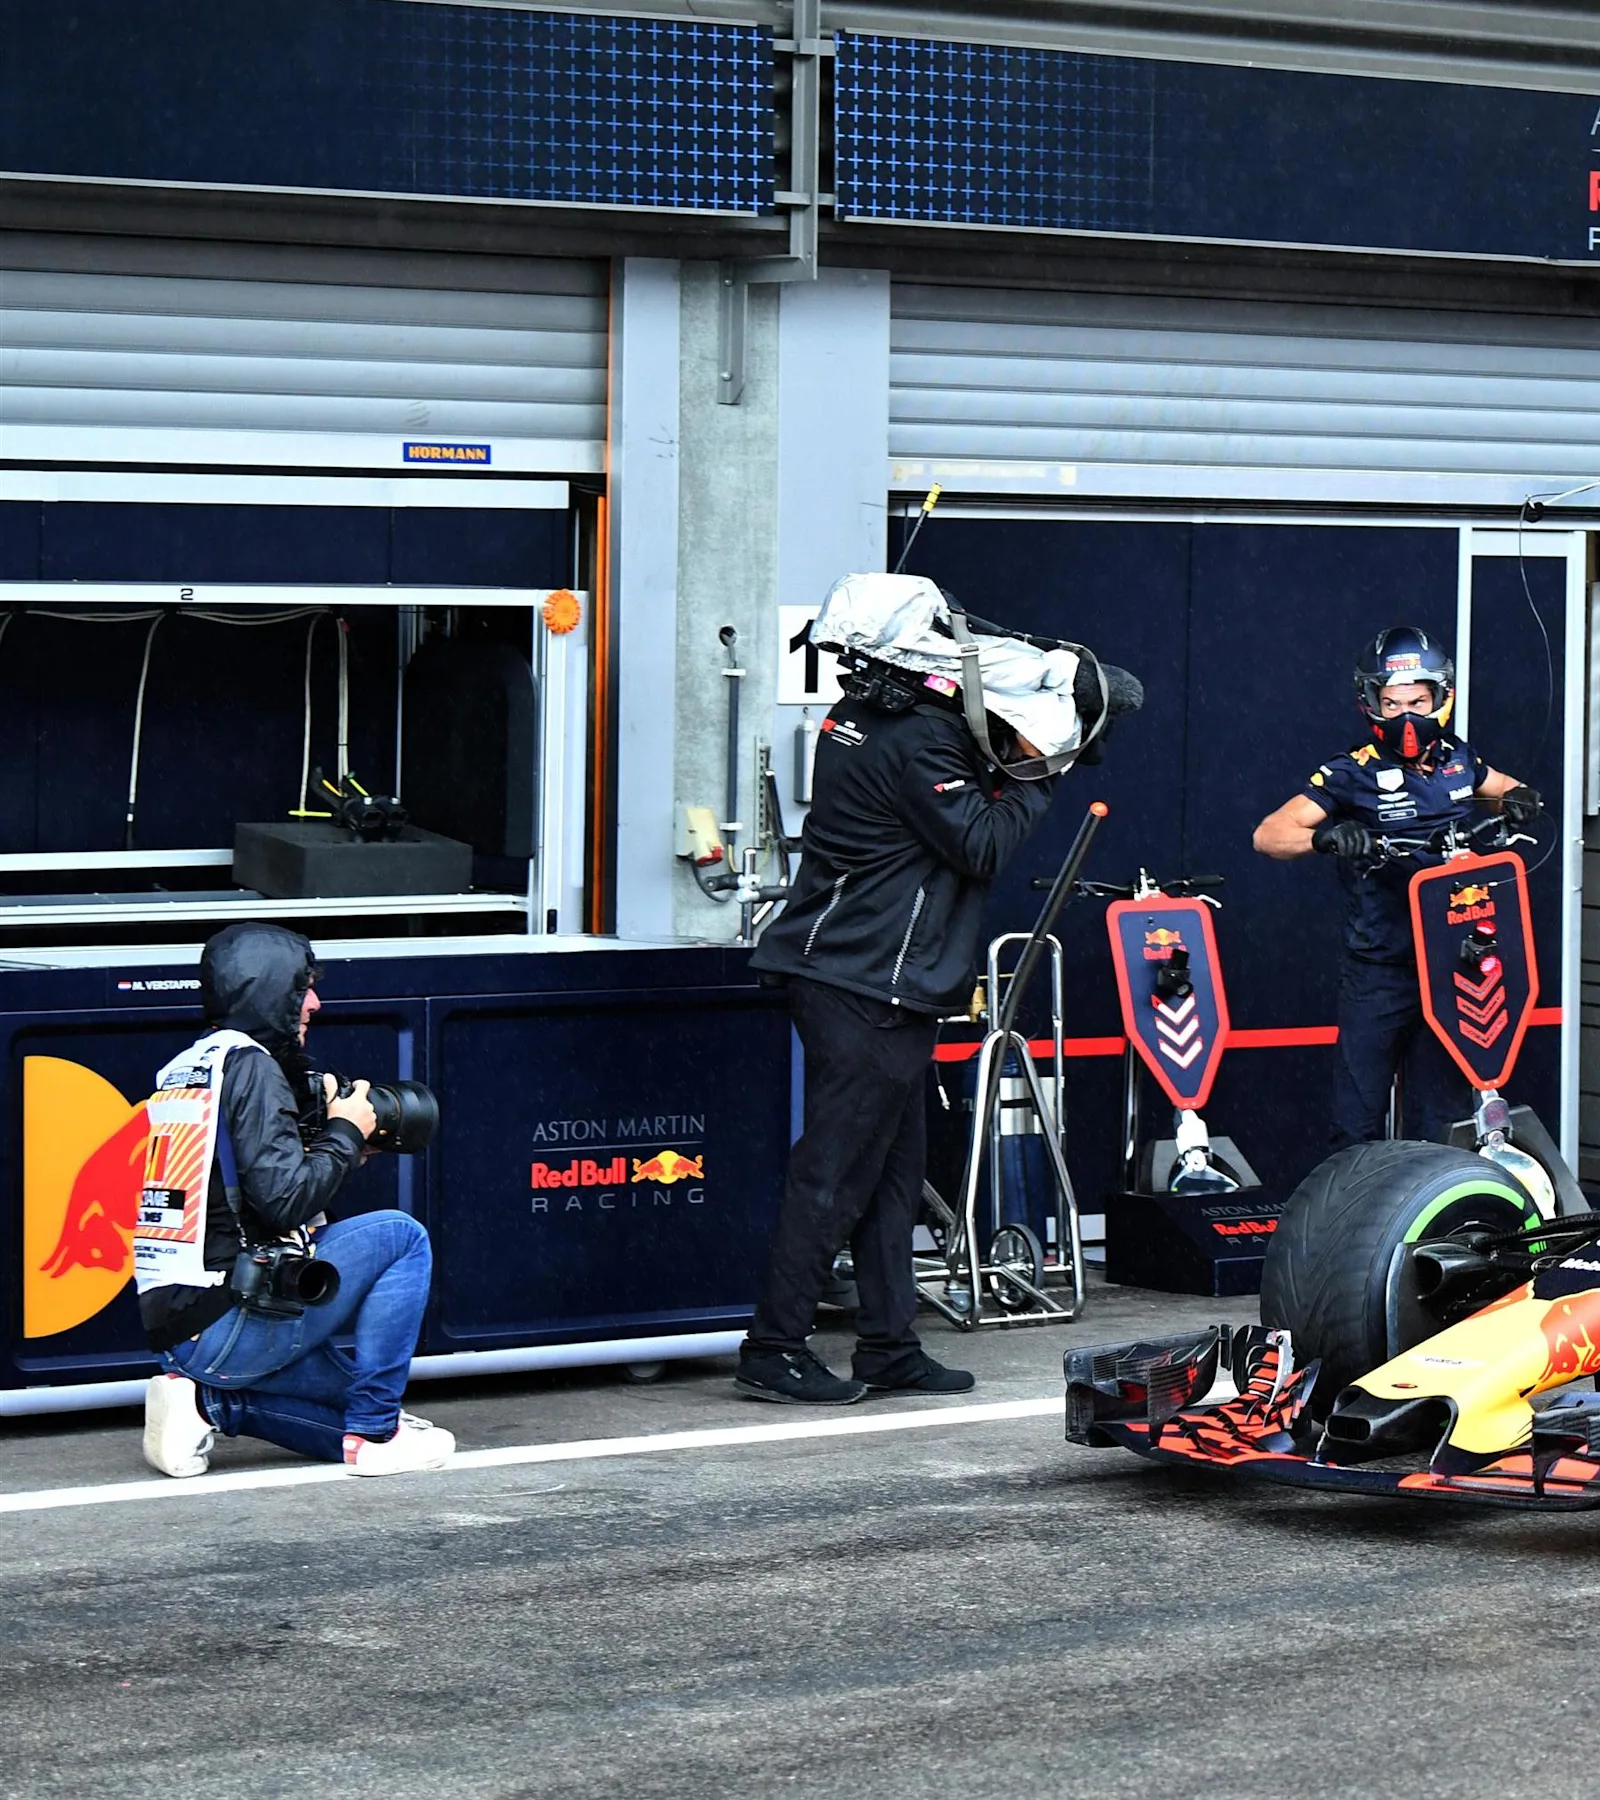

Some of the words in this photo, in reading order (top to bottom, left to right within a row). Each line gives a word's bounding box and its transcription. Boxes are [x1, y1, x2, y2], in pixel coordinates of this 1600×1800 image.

[180, 588, 194, 601] 2
[1446, 904, 1473, 925] Red
[533, 1119, 606, 1142] ASTON
[616, 1114, 705, 1138] MARTIN
[531, 1188, 704, 1213] RACING
